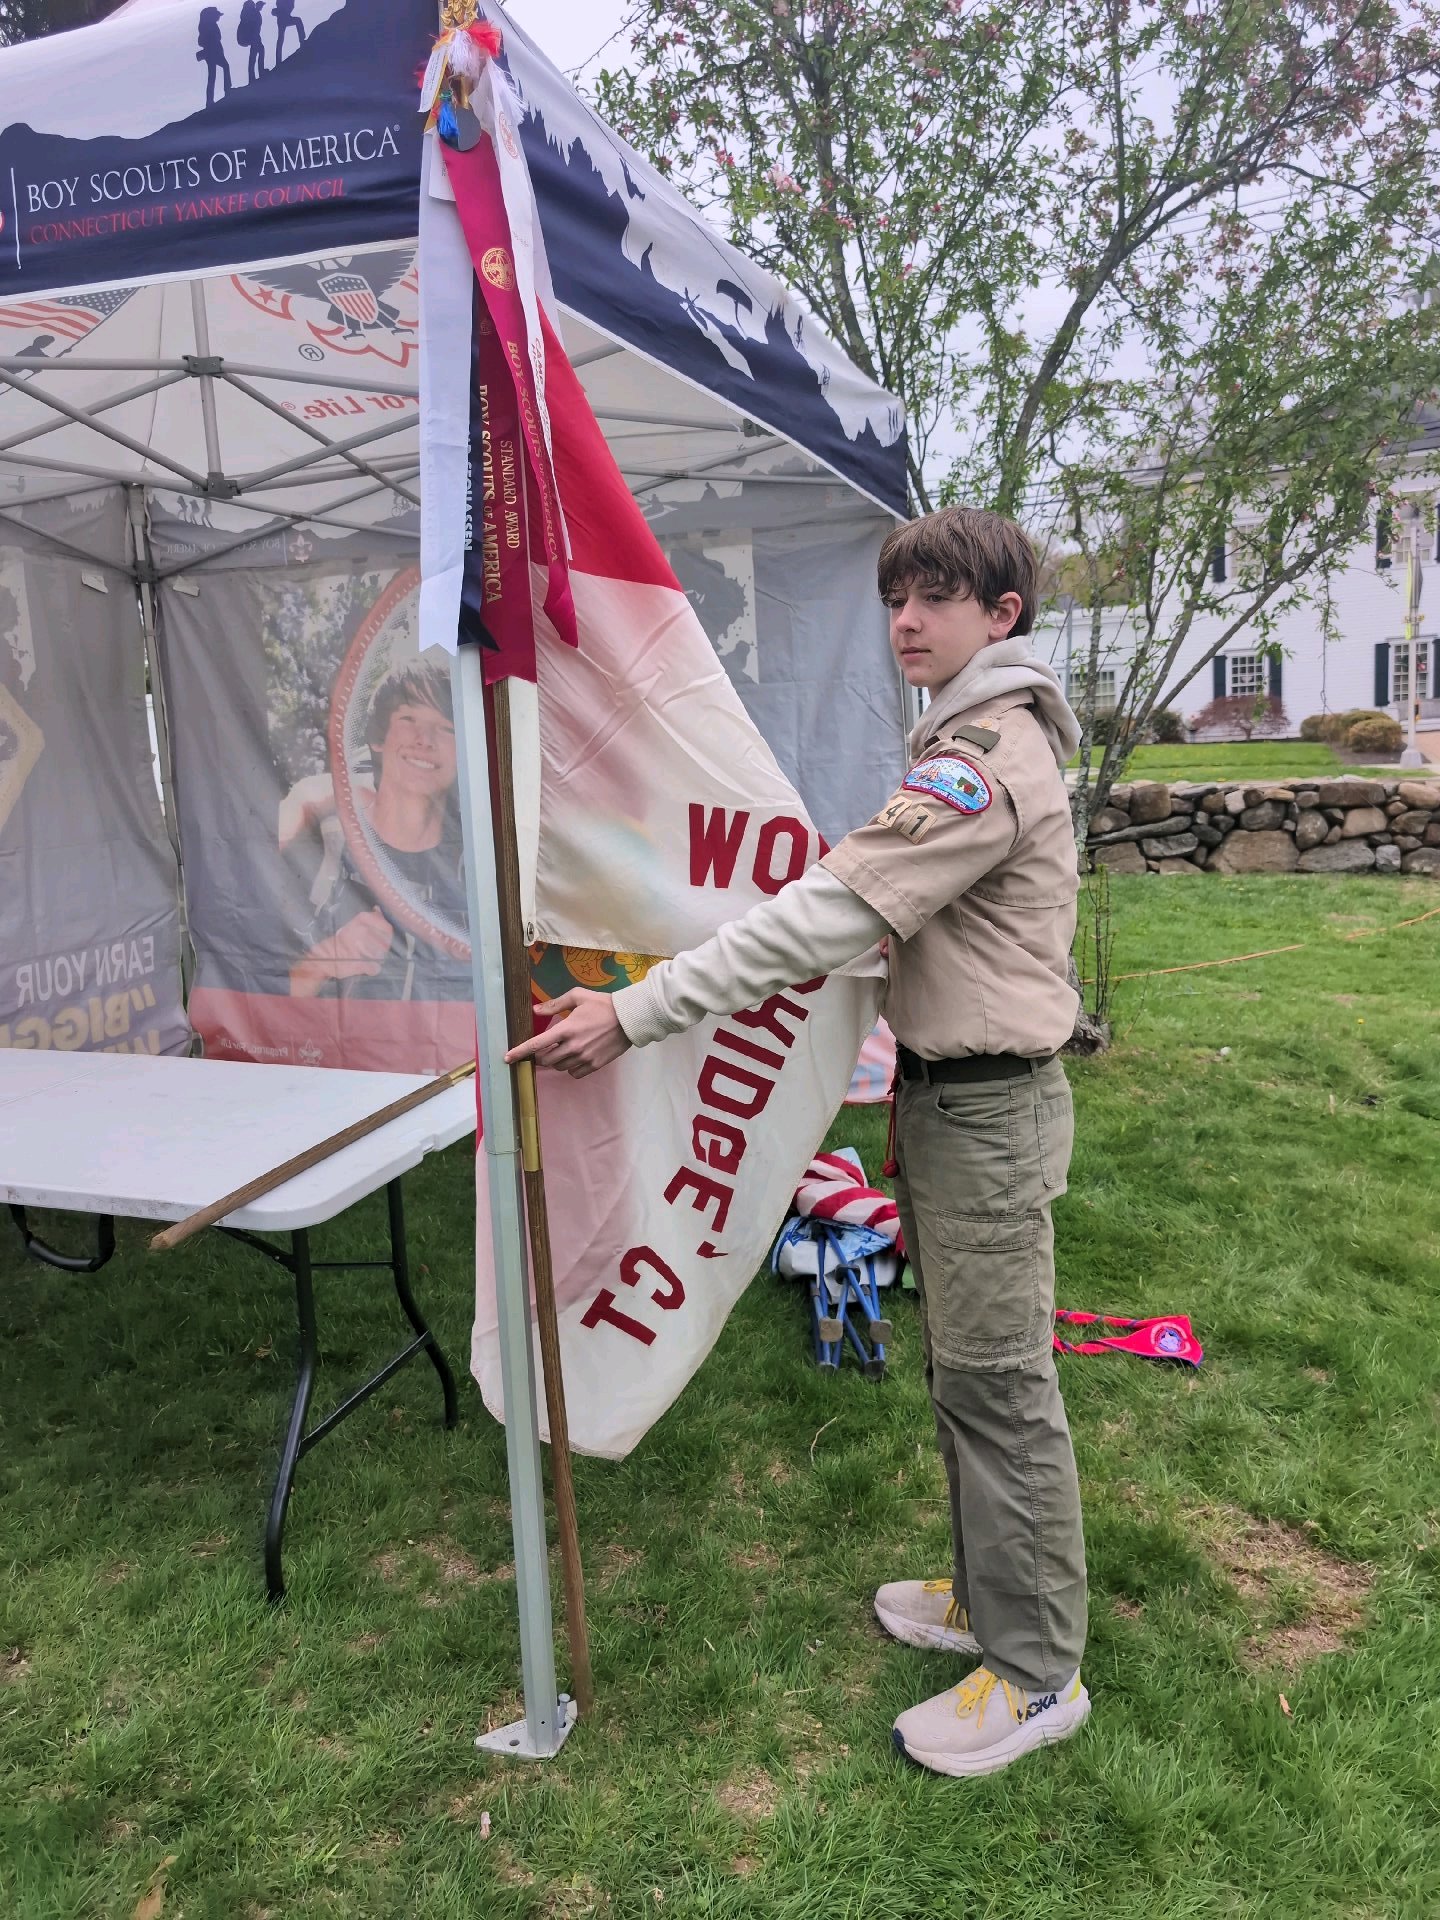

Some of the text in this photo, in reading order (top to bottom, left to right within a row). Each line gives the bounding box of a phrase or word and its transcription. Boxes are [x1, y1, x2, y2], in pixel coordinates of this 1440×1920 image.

[27, 176, 79, 213] BOY
[90, 157, 200, 203] SCOUTS
[209, 148, 247, 183] OF
[259, 126, 400, 176] AMERICA
[31, 177, 347, 245] CONNECTICUT YANKEE COUNCIL
[507, 340, 525, 383] BOY
[520, 386, 541, 458] SCOUTS
[540, 479, 558, 561] AMERICA
[484, 505, 493, 519] OF
[500, 440, 521, 549] STANDARD AWARD
[483, 521, 503, 604] AMERICA
